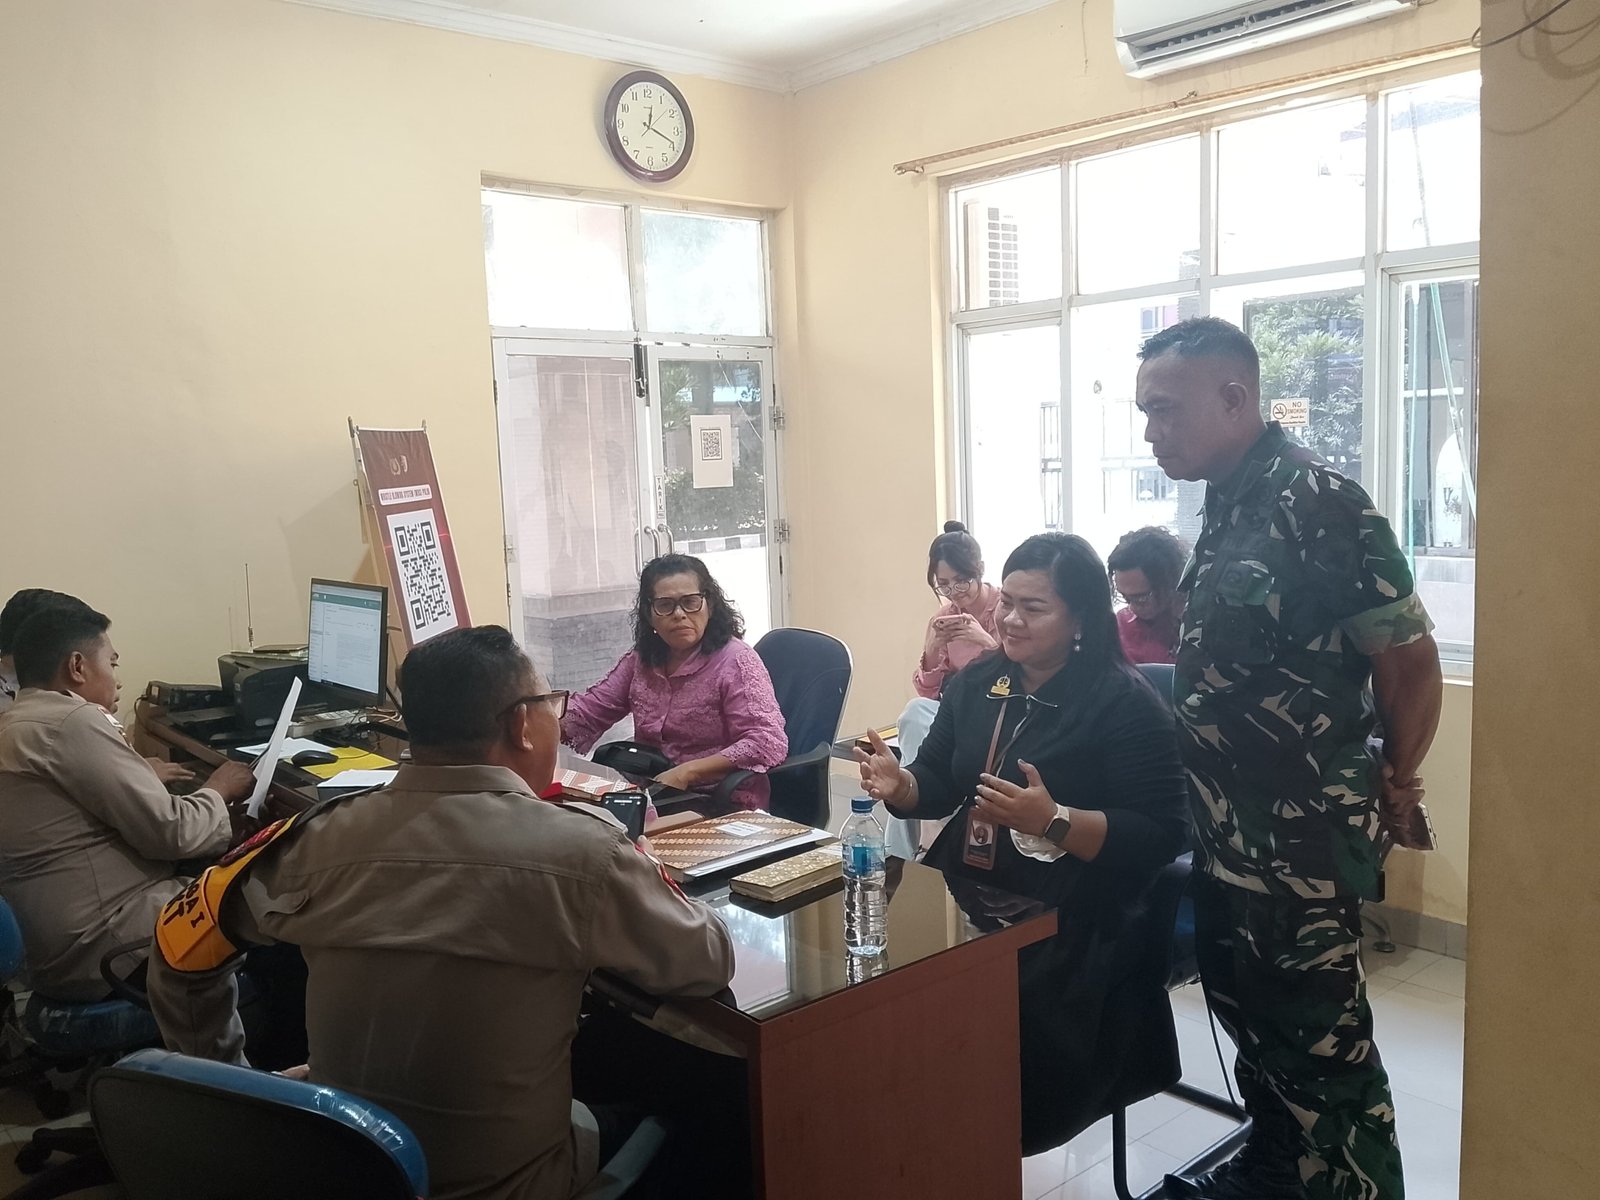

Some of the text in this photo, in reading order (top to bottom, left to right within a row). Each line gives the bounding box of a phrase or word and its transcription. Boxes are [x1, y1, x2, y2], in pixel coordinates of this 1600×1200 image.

[632, 92, 638, 101] 11
[643, 89, 652, 98] 12
[621, 104, 629, 113] 10
[669, 109, 675, 118] 2
[618, 119, 624, 128] 9
[673, 127, 680, 136] 3
[622, 136, 629, 146] 8
[634, 150, 640, 159] 7
[662, 153, 668, 162] 5
[648, 156, 654, 166] 6
